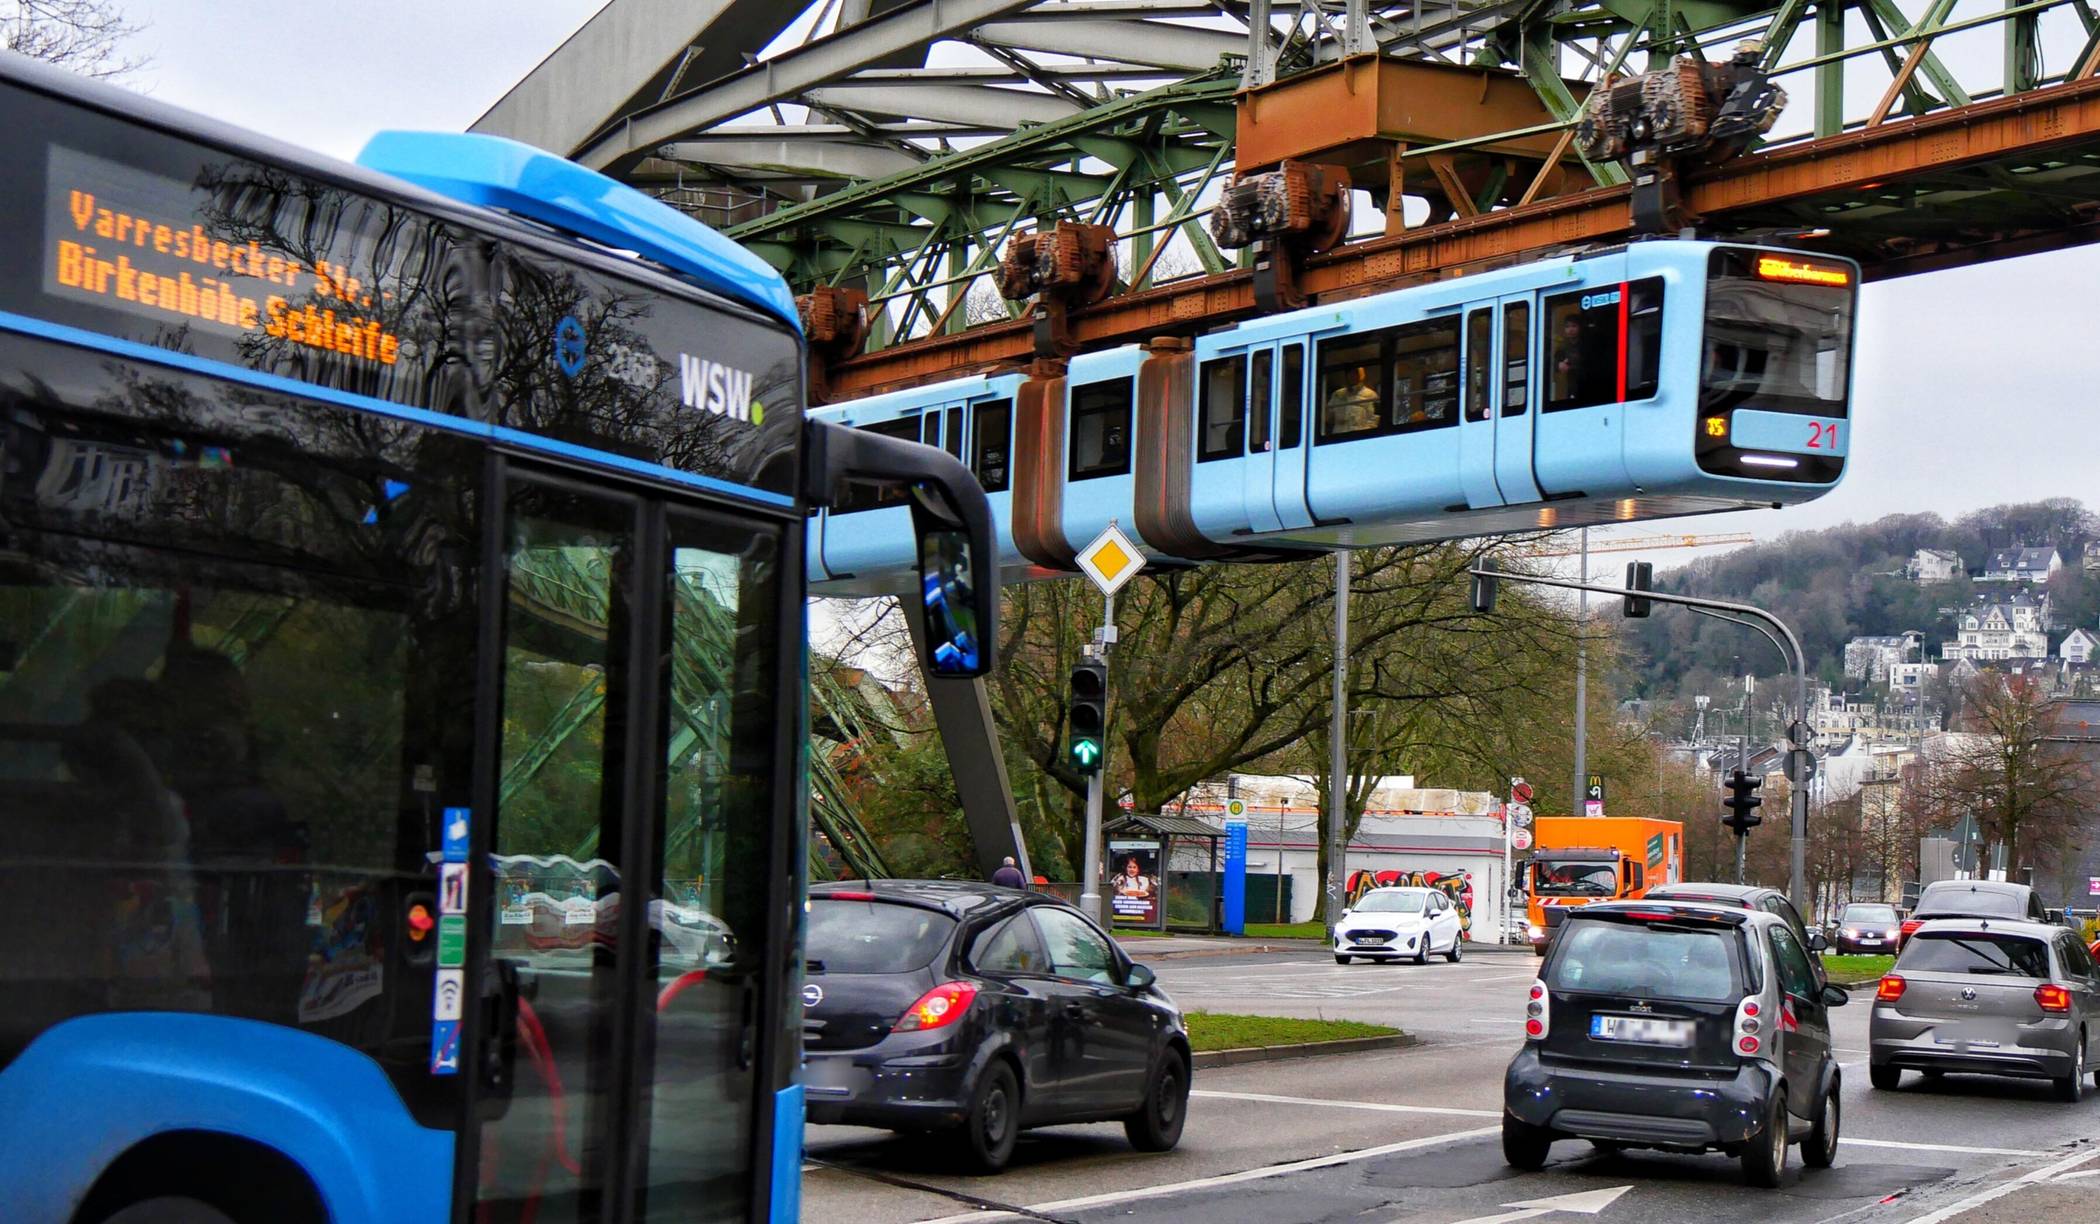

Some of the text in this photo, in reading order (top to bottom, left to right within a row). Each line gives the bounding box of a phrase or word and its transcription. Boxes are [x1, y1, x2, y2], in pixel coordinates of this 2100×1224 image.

[70, 190, 301, 286] Varresbecker
[57, 239, 398, 365] Birkenhöhe Schleife
[1807, 421, 1837, 449] 21
